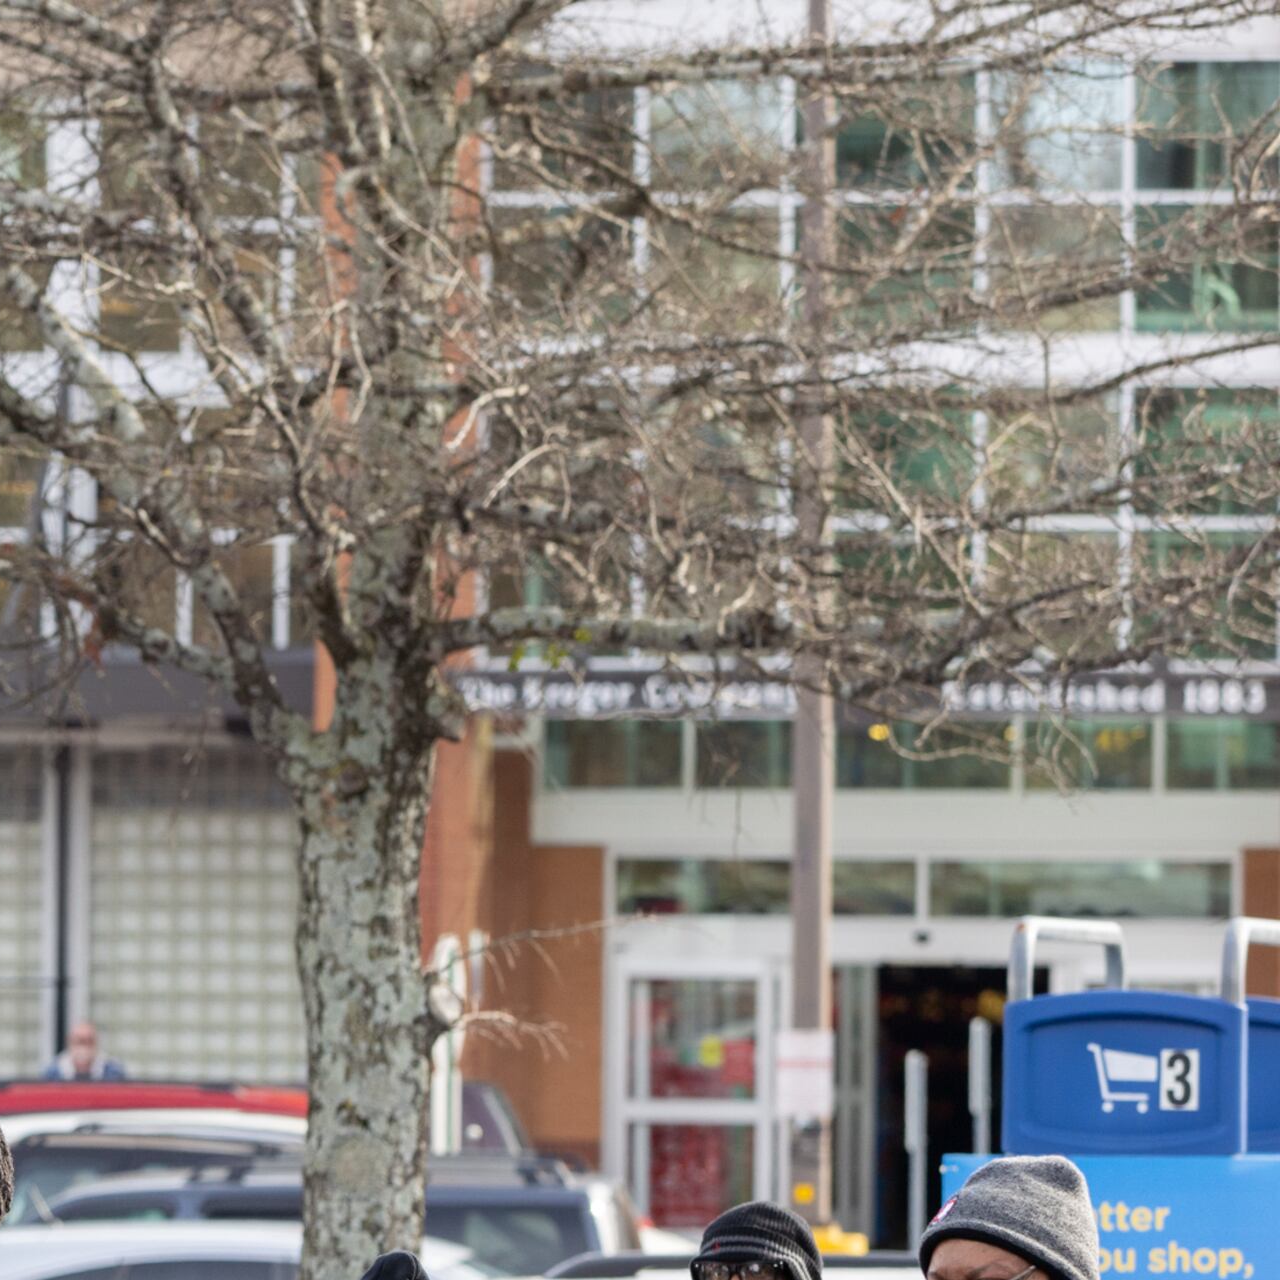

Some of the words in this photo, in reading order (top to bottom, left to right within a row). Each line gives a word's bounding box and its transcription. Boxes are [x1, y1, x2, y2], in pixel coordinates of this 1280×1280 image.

[1167, 1051, 1191, 1108] 3
[1095, 1201, 1170, 1232] tter
[1099, 1247, 1136, 1273] ou
[1148, 1240, 1254, 1280] shop,
